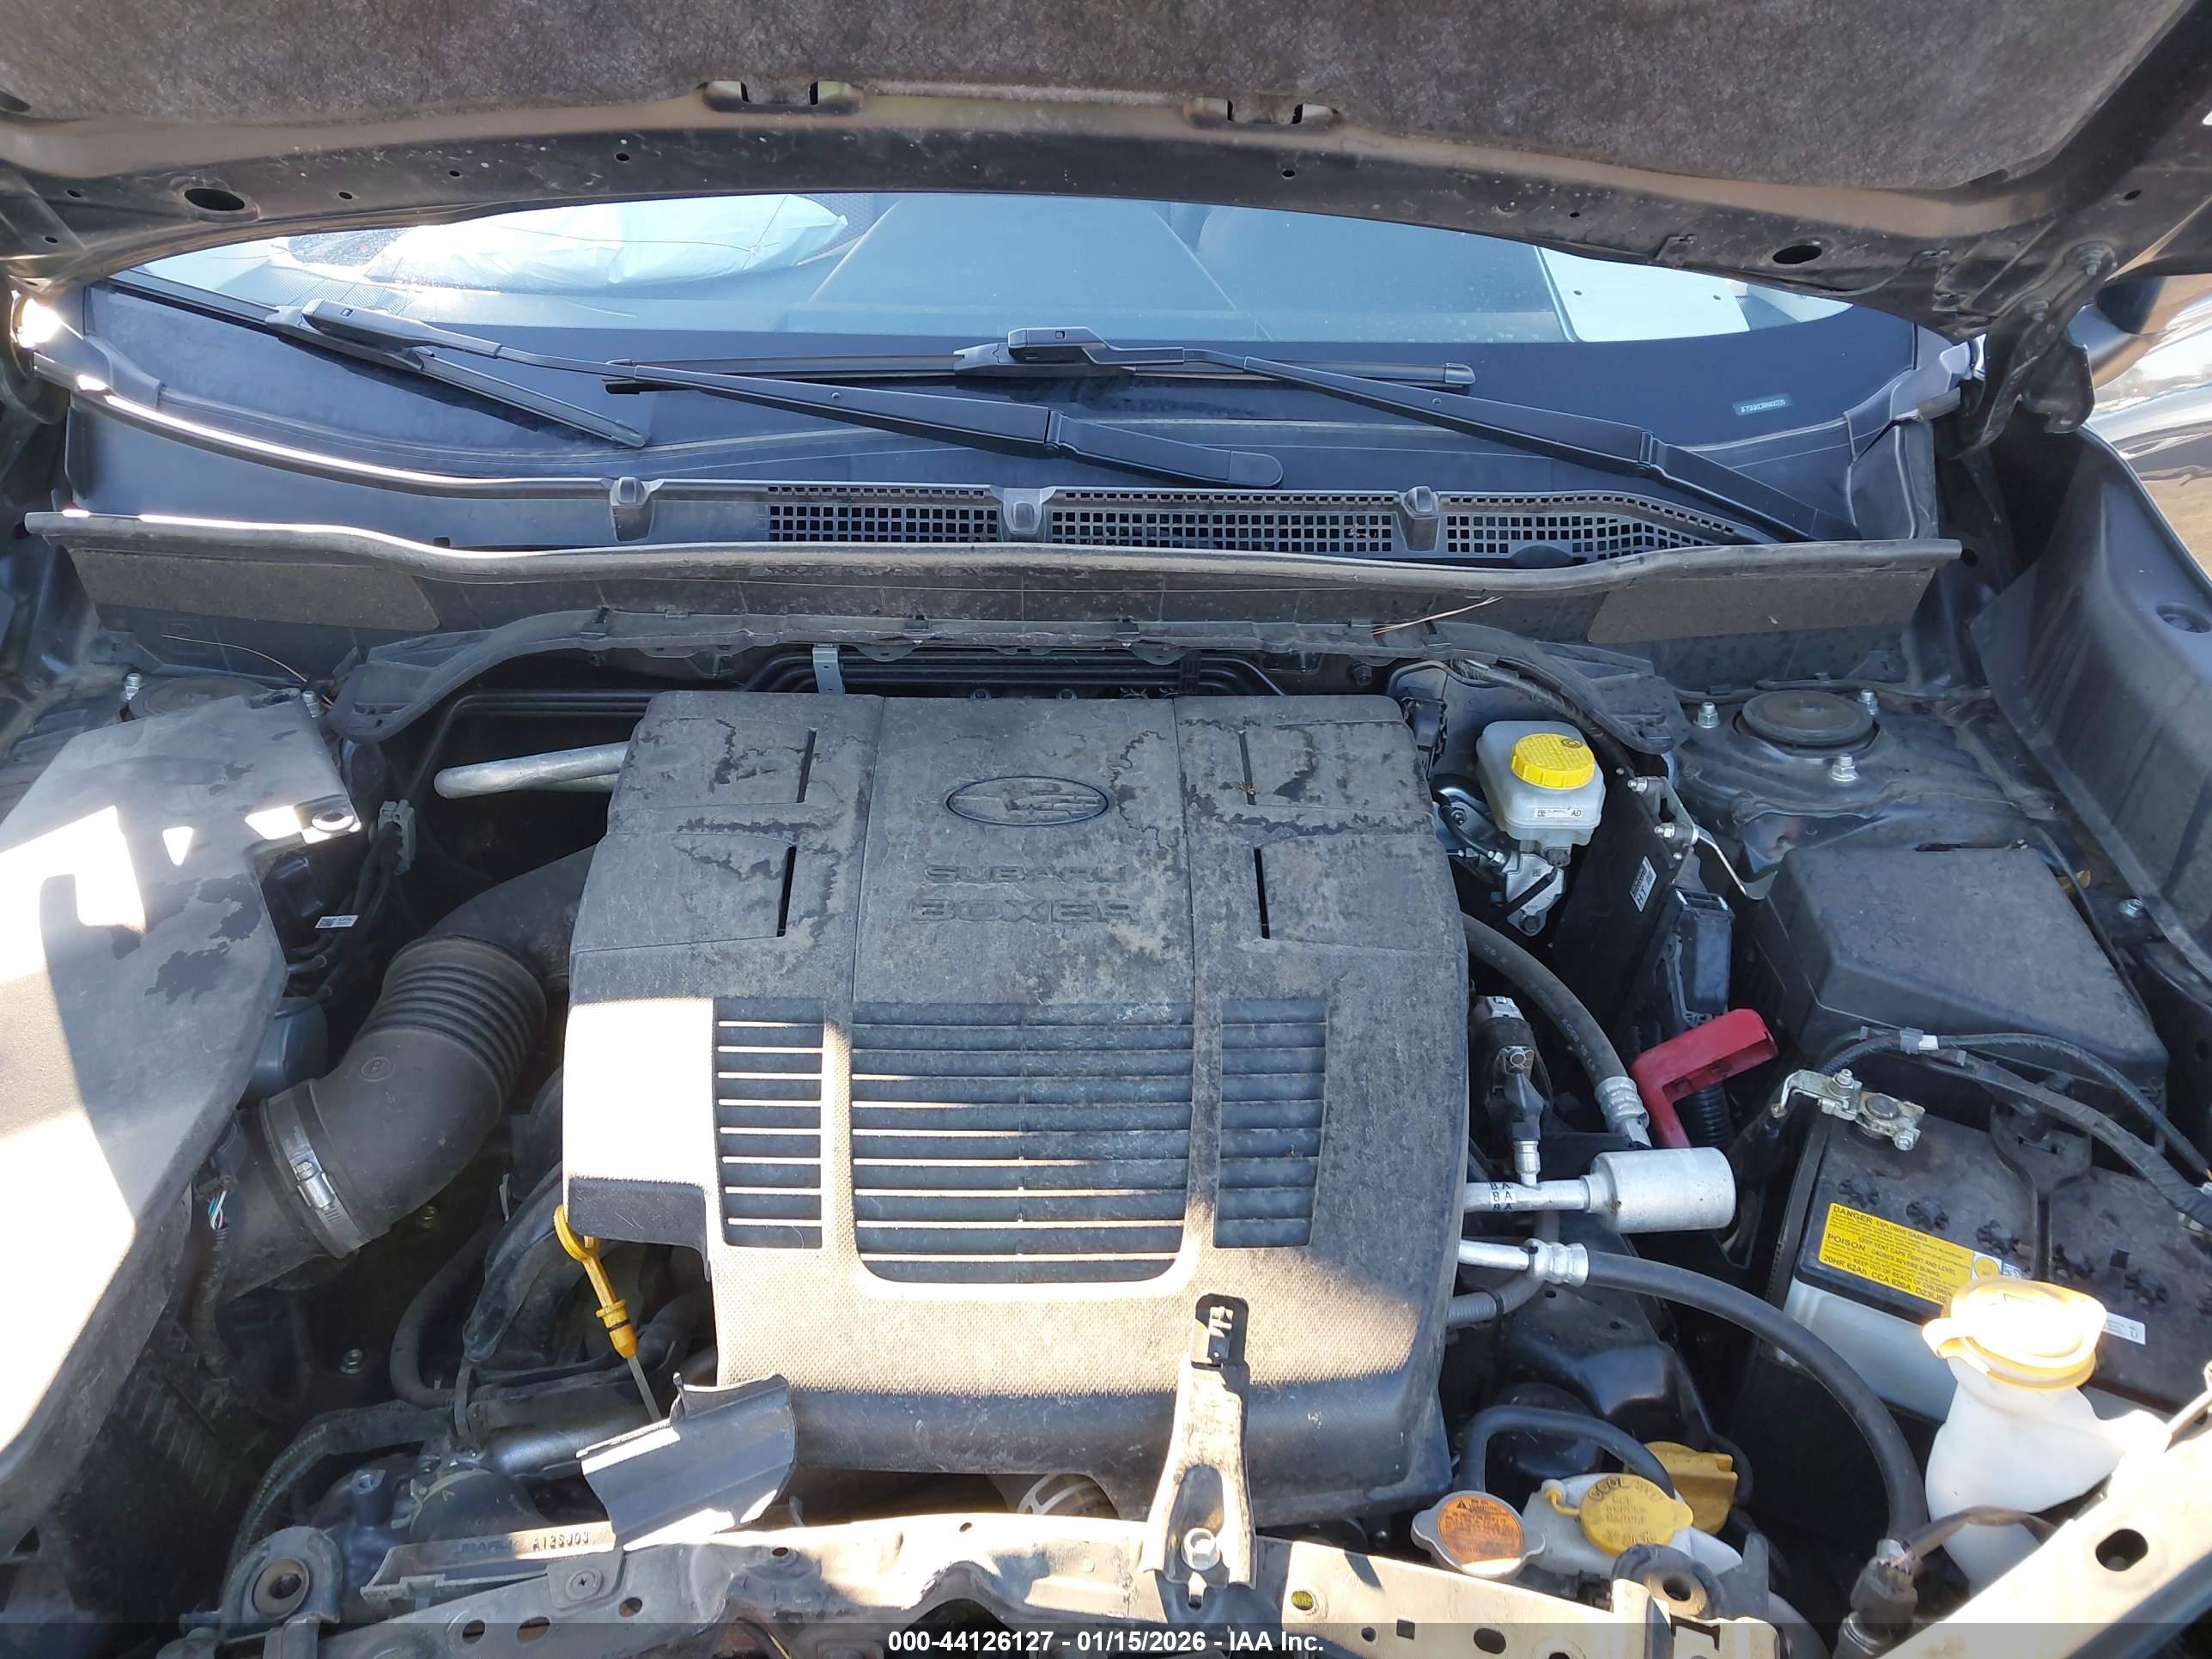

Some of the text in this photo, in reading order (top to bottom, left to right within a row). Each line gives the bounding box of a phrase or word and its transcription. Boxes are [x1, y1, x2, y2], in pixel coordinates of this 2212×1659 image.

[923, 865, 1127, 884] SUBARU
[1832, 1205, 1873, 1224] DANGER
[1826, 1232, 1866, 1251] POISON
[1823, 1254, 1844, 1267] 20HR
[1845, 1262, 1867, 1275] 62Ah
[1870, 1271, 1889, 1283] CCA
